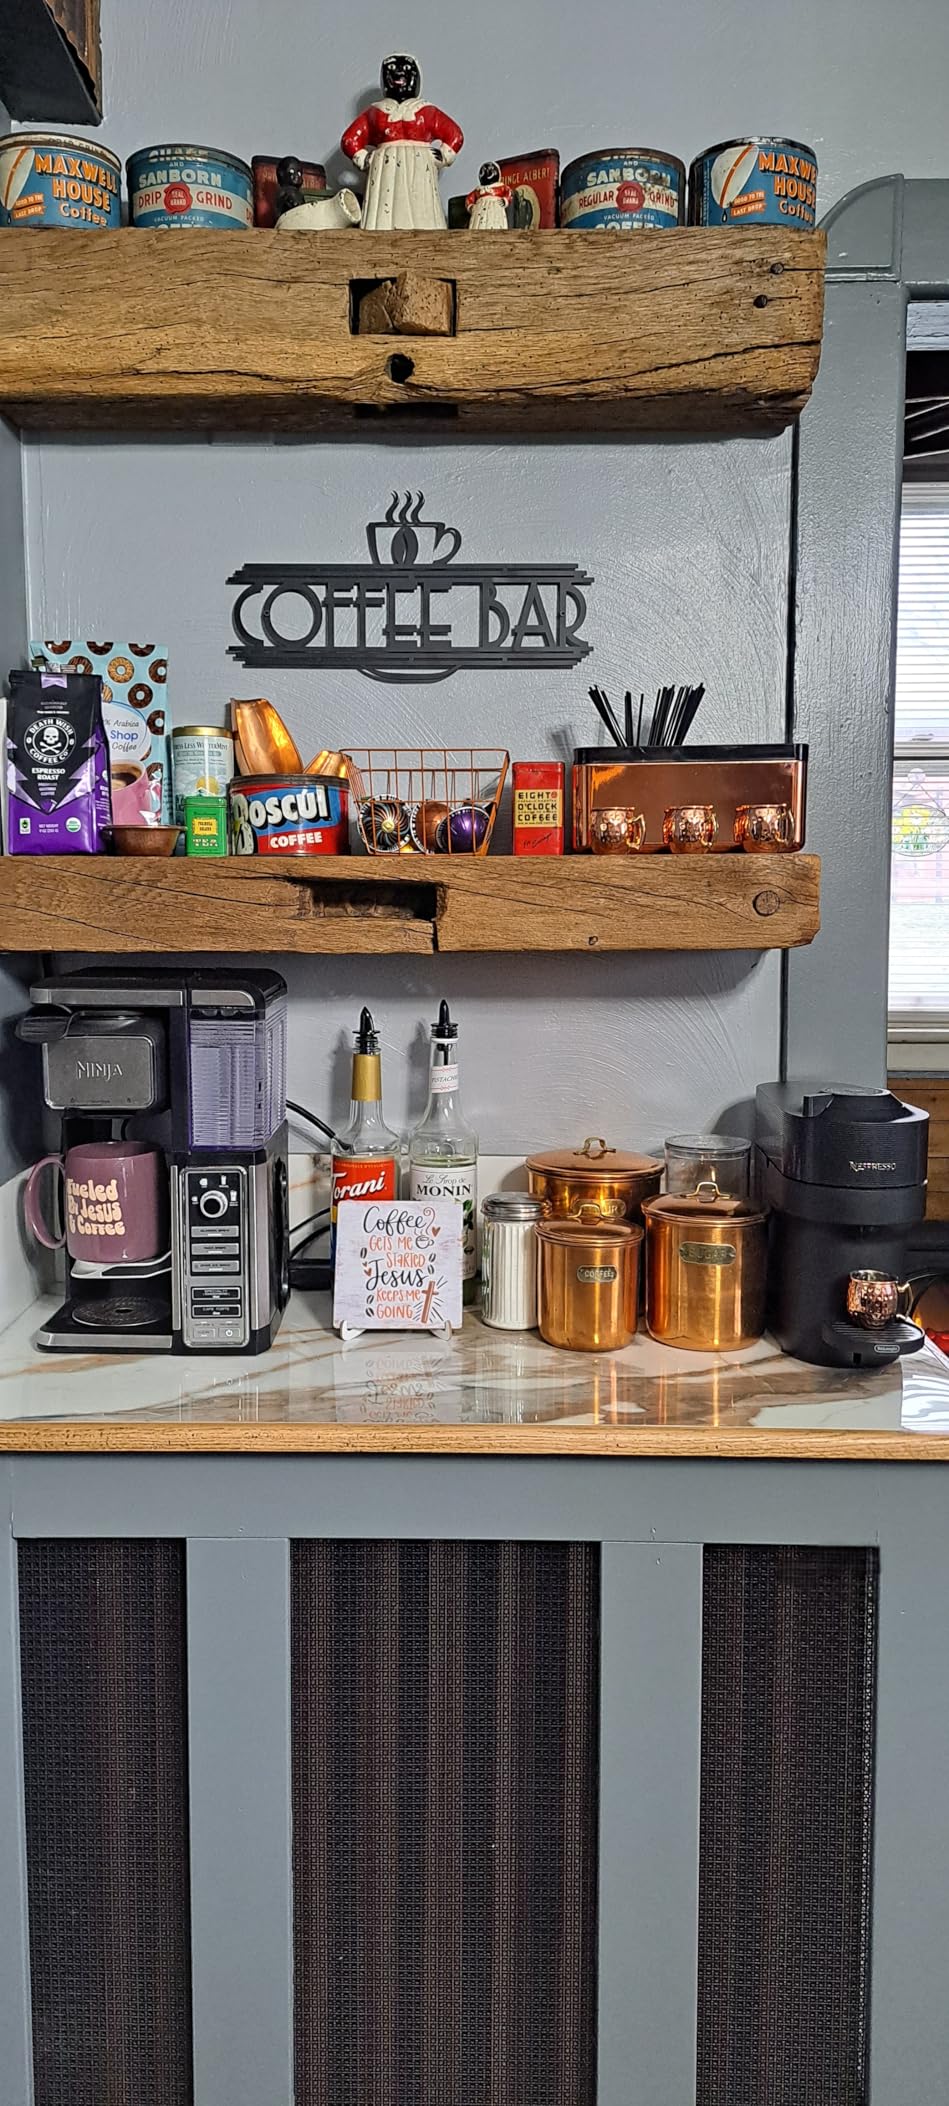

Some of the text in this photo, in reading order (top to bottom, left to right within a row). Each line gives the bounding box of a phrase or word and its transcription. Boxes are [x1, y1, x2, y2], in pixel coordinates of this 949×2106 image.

[35, 153, 118, 194] MAXWELL
[138, 168, 222, 188] SANBORN
[523, 167, 550, 182] ALBERT
[586, 167, 671, 187] SANBORN
[53, 177, 110, 212] HOUSE
[138, 190, 233, 210] DRIP GRIND
[579, 190, 676, 209] REGULAR GRIND
[60, 202, 107, 226] Coffee
[603, 213, 655, 221] VACUUM PACKED
[733, 207, 747, 217] LAST
[231, 583, 594, 650] COFFEE BAR
[29, 718, 74, 735] DEATH WISH
[114, 719, 140, 728] Arabica
[110, 729, 139, 742] Shop
[111, 741, 137, 752] Coffee
[31, 767, 66, 775] ESPRESSO
[518, 791, 551, 800] EIGHT
[517, 803, 558, 811] O'CLOCK
[517, 813, 558, 822] COFFEE
[192, 838, 219, 847] TEA
[270, 831, 323, 849] COFFEE
[76, 1060, 123, 1082] NINJA
[66, 1178, 119, 1202] Fueled
[332, 1171, 386, 1200] Torani
[416, 1183, 471, 1197] MONIN
[80, 1198, 122, 1223] Jesus
[77, 1214, 126, 1236] Coffee
[363, 1205, 427, 1237] Coffee
[366, 1258, 429, 1291] Jesus
[376, 1303, 413, 1320] GOING
